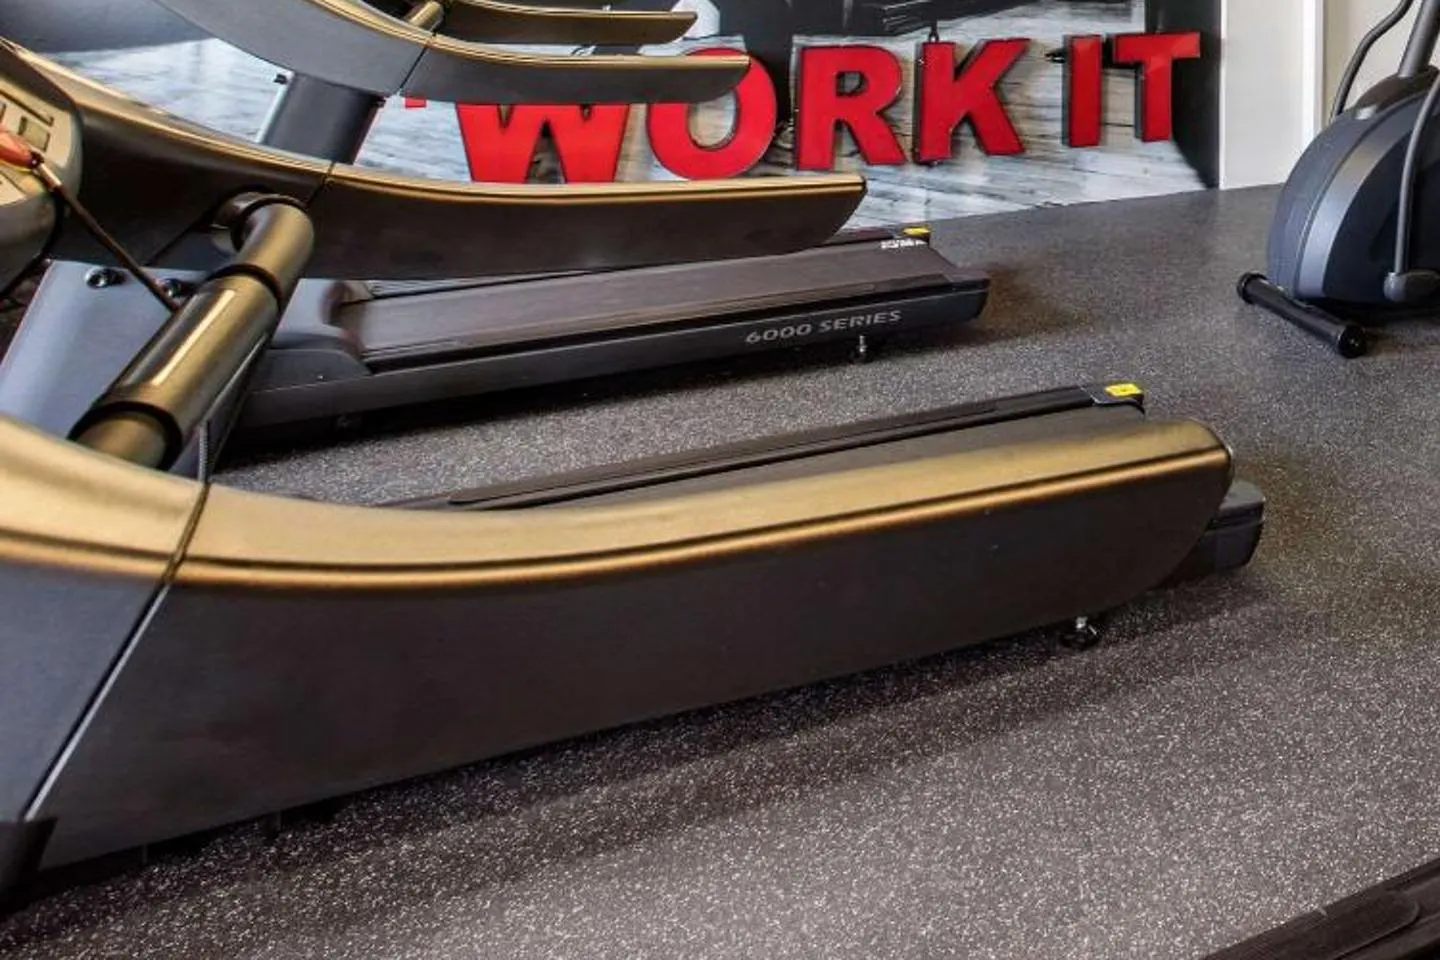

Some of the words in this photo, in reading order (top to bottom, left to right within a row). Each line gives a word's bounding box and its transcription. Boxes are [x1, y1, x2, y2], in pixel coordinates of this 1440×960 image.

[456, 38, 1030, 184] WORK
[1060, 31, 1201, 148] IT
[745, 323, 812, 344] 6000
[818, 309, 902, 333] SERIES
